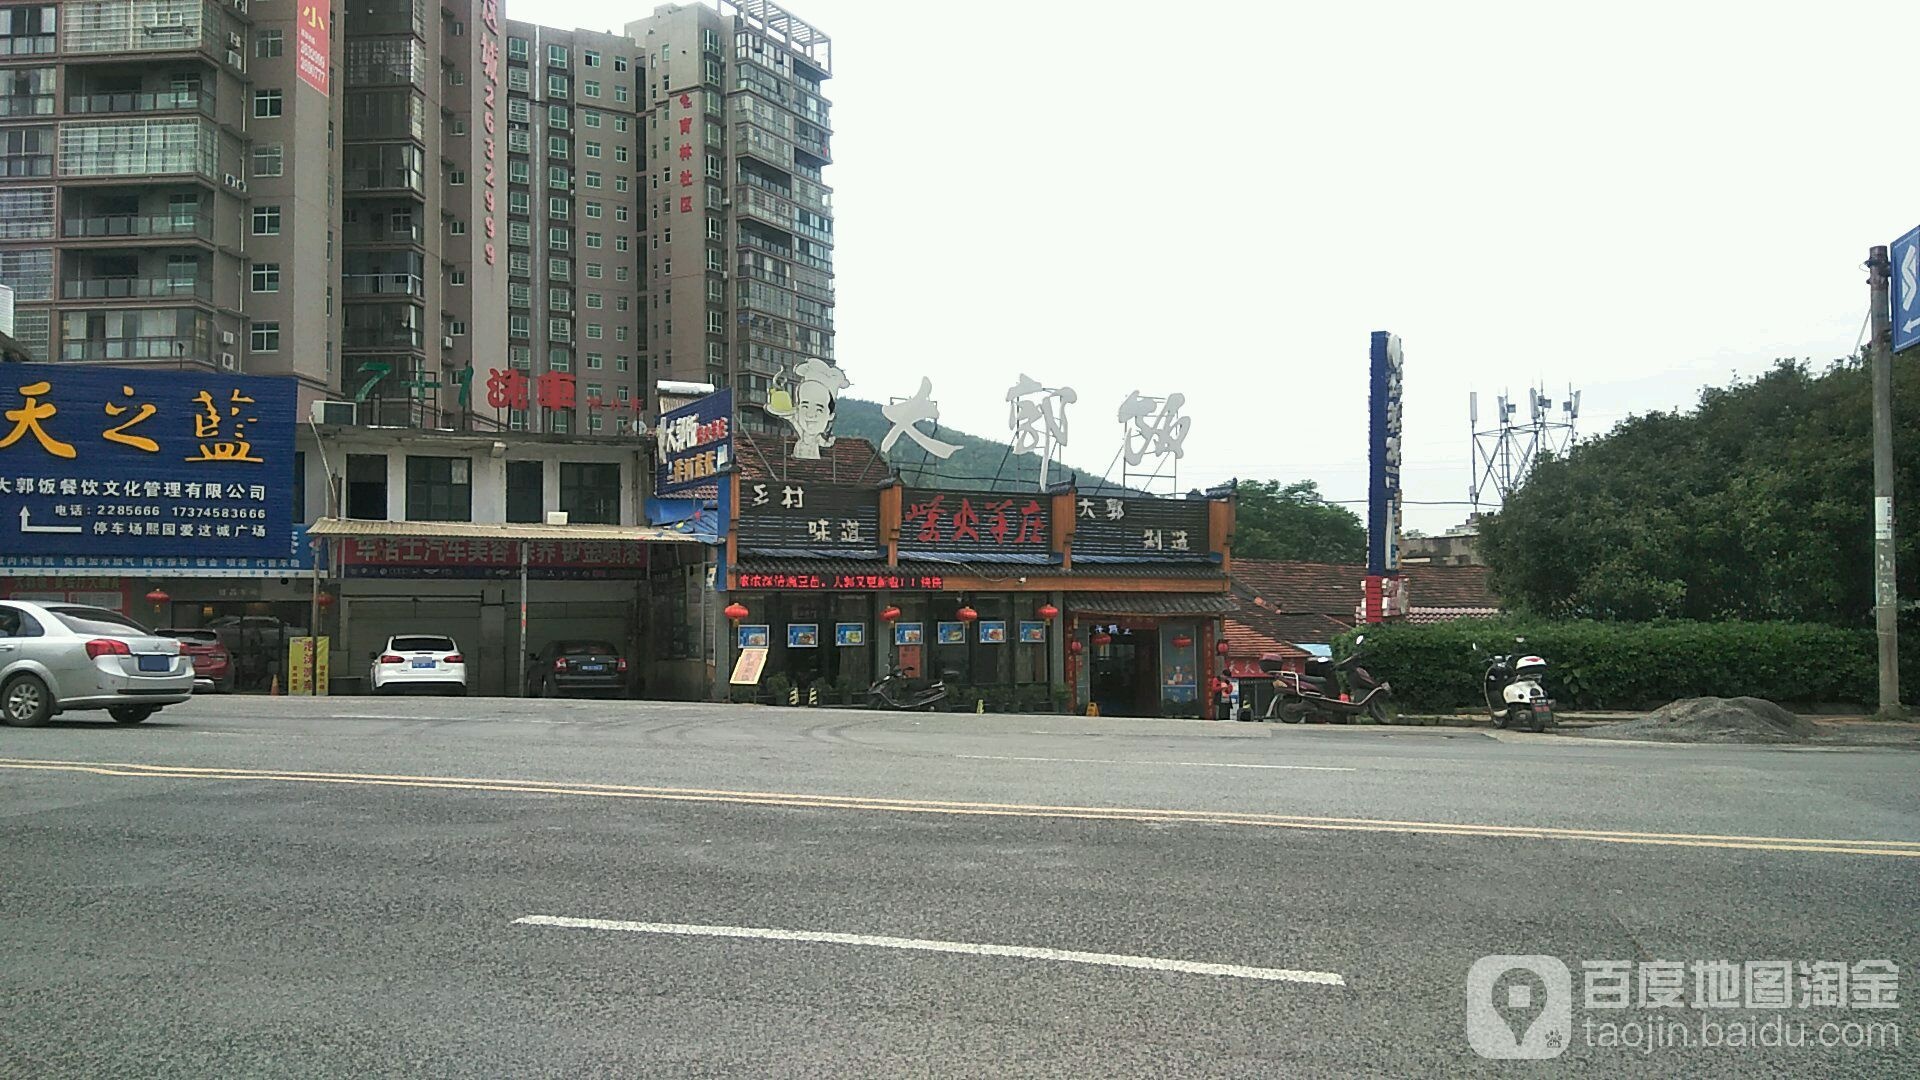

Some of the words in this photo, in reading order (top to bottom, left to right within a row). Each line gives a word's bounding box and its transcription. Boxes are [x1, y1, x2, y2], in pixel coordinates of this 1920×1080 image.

[0, 477, 266, 501] 大郭饭餐饮文化管理有限公司
[752, 484, 804, 509] 乡村
[171, 506, 266, 519] 17374583666
[1079, 498, 1125, 521] 大郭
[807, 519, 865, 544] 味道
[1144, 528, 1190, 551] 制造
